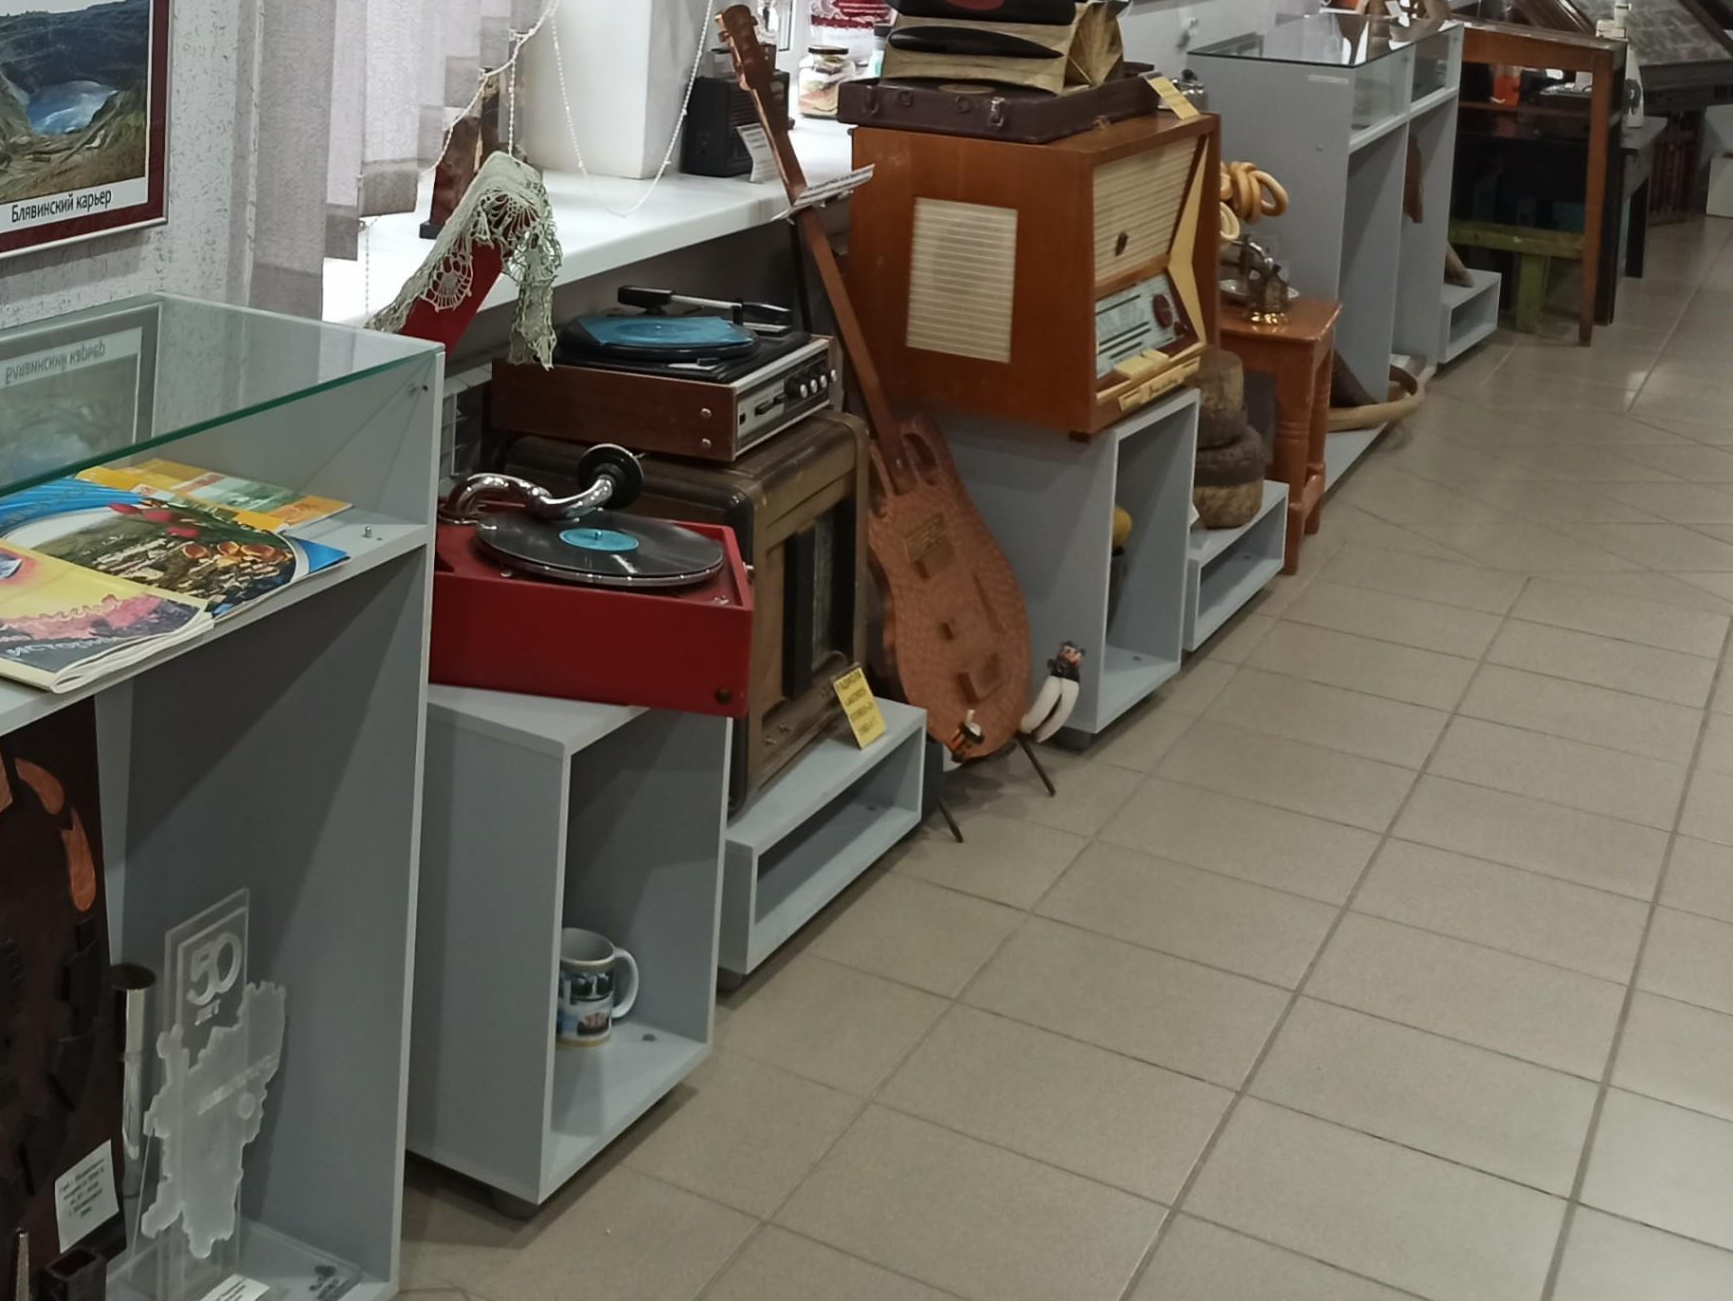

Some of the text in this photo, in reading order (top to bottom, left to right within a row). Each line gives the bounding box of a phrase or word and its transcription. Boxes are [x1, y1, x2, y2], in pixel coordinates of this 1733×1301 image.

[11, 189, 112, 223] Блявинский карьер
[186, 930, 243, 1007] 50
